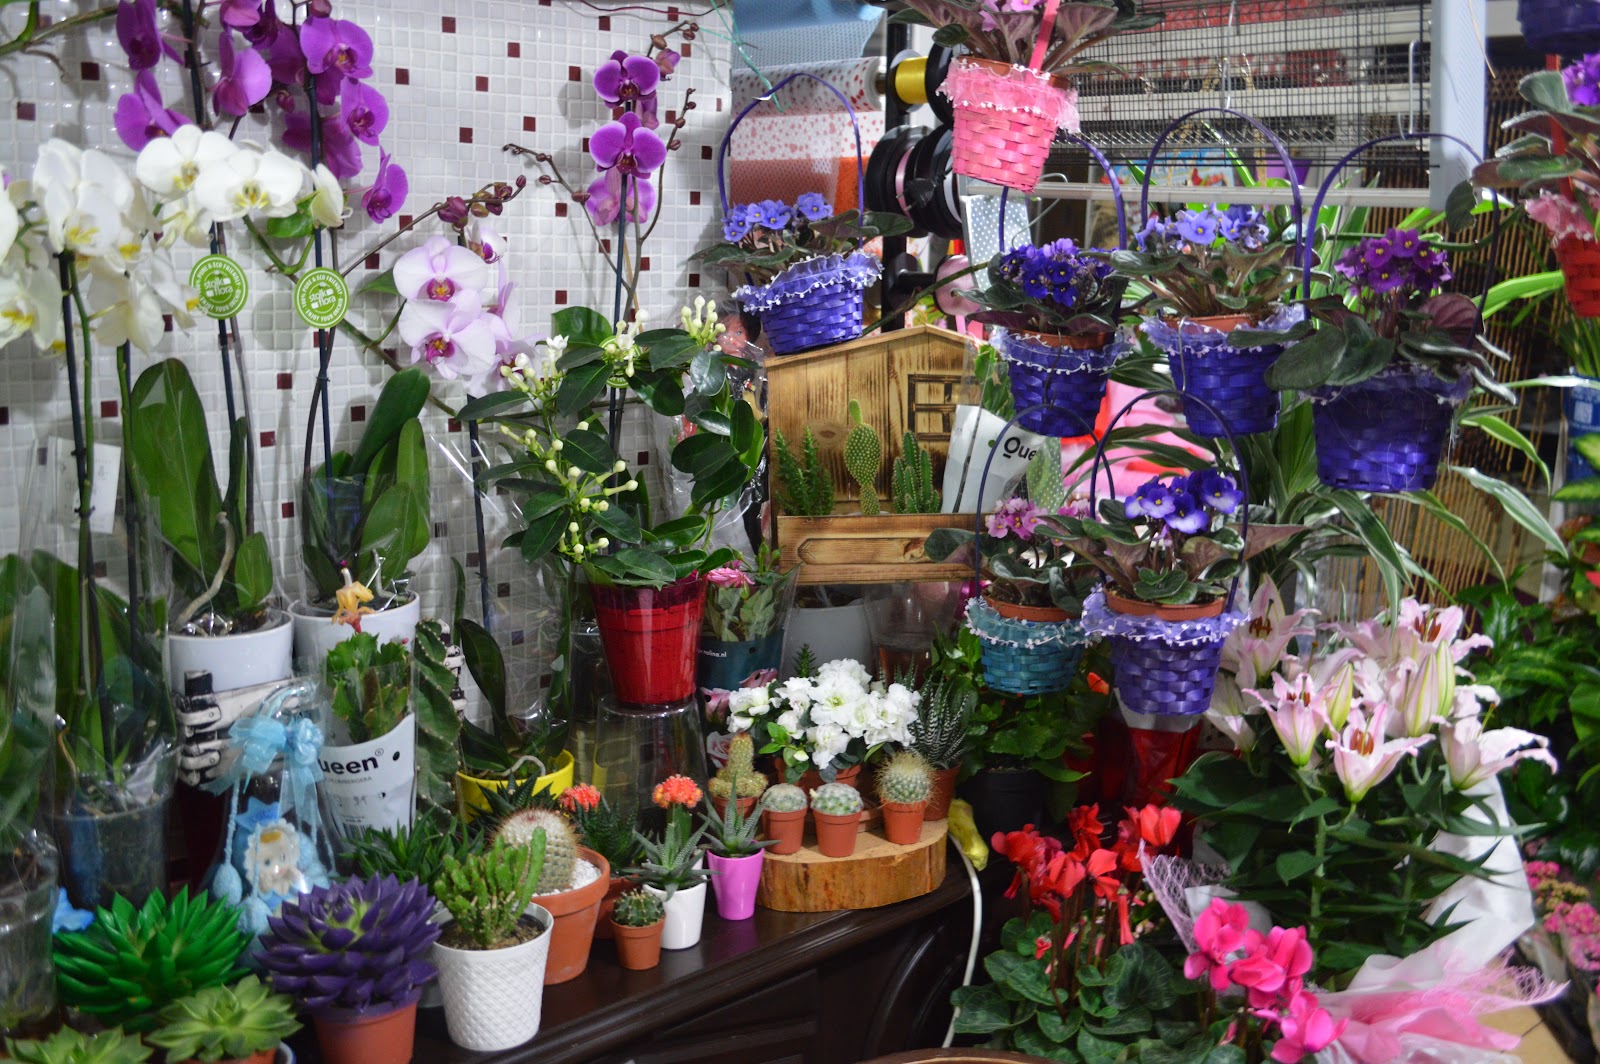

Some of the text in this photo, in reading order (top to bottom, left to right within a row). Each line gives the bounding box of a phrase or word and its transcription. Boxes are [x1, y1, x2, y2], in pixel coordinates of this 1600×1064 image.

[203, 276, 224, 290] stolk
[213, 285, 234, 297] flora
[308, 288, 327, 303] stolk
[319, 295, 337, 308] flora
[1002, 436, 1037, 461] Que
[317, 756, 379, 775] ueen
